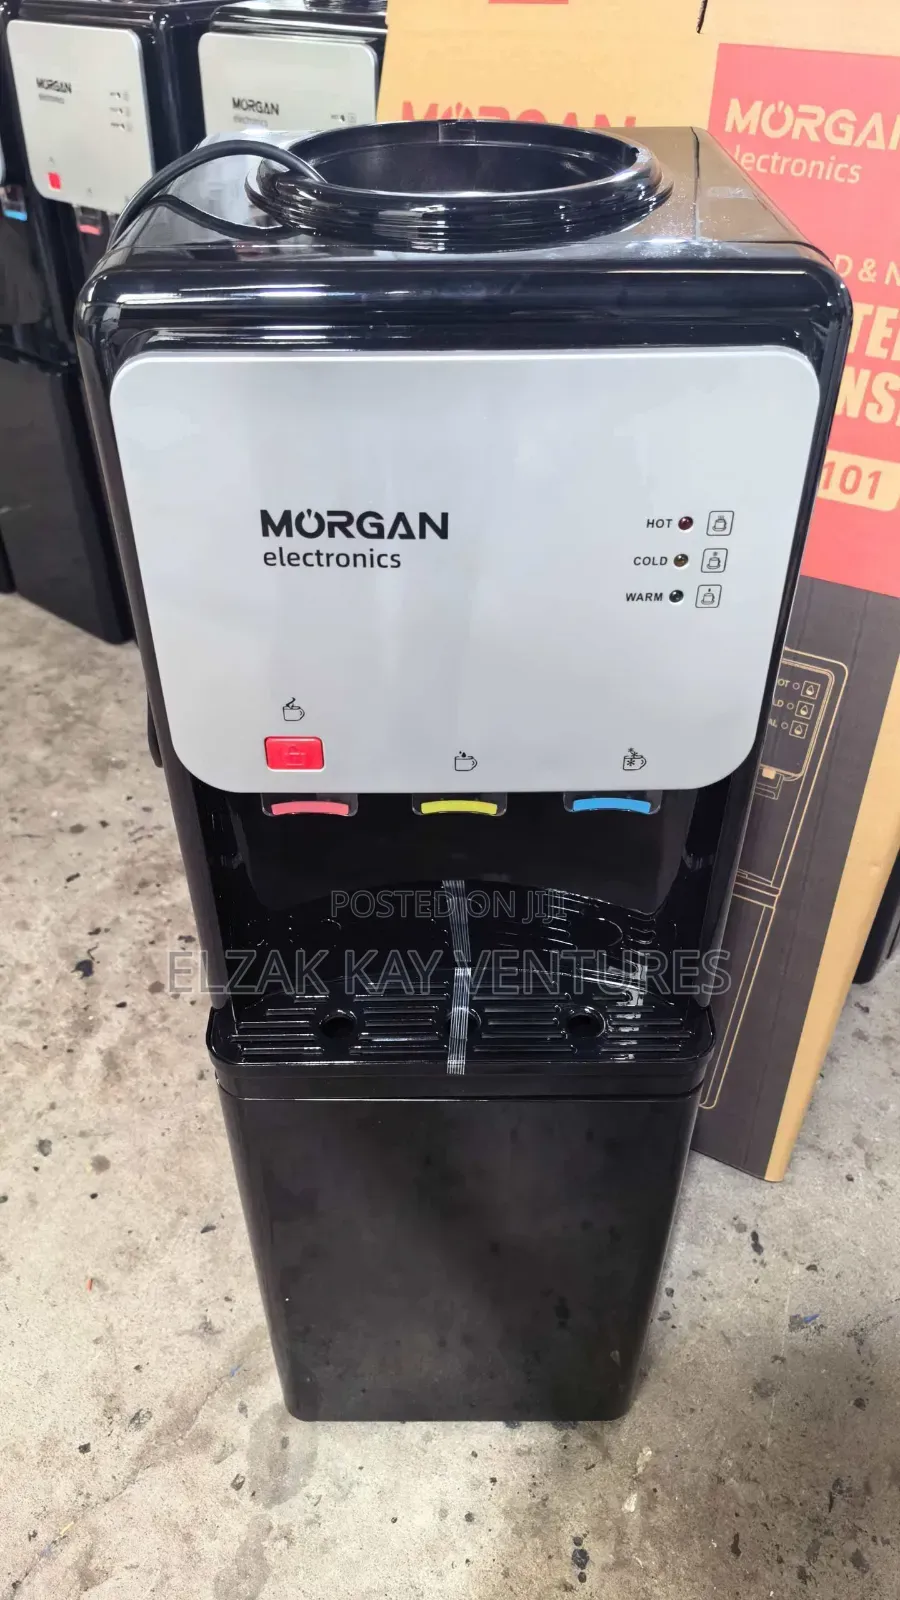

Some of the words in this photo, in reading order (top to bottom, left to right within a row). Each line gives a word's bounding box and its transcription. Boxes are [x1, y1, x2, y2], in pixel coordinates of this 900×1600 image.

[232, 97, 279, 115] MORGAN
[734, 144, 863, 184] lectronics
[857, 257, 878, 283] &
[823, 460, 882, 500] 101
[260, 508, 449, 540] MORGAN
[646, 518, 673, 529] HOT
[263, 546, 401, 569] electronics
[633, 556, 668, 566] COLD
[625, 592, 664, 602] WARM
[777, 678, 790, 688] OT
